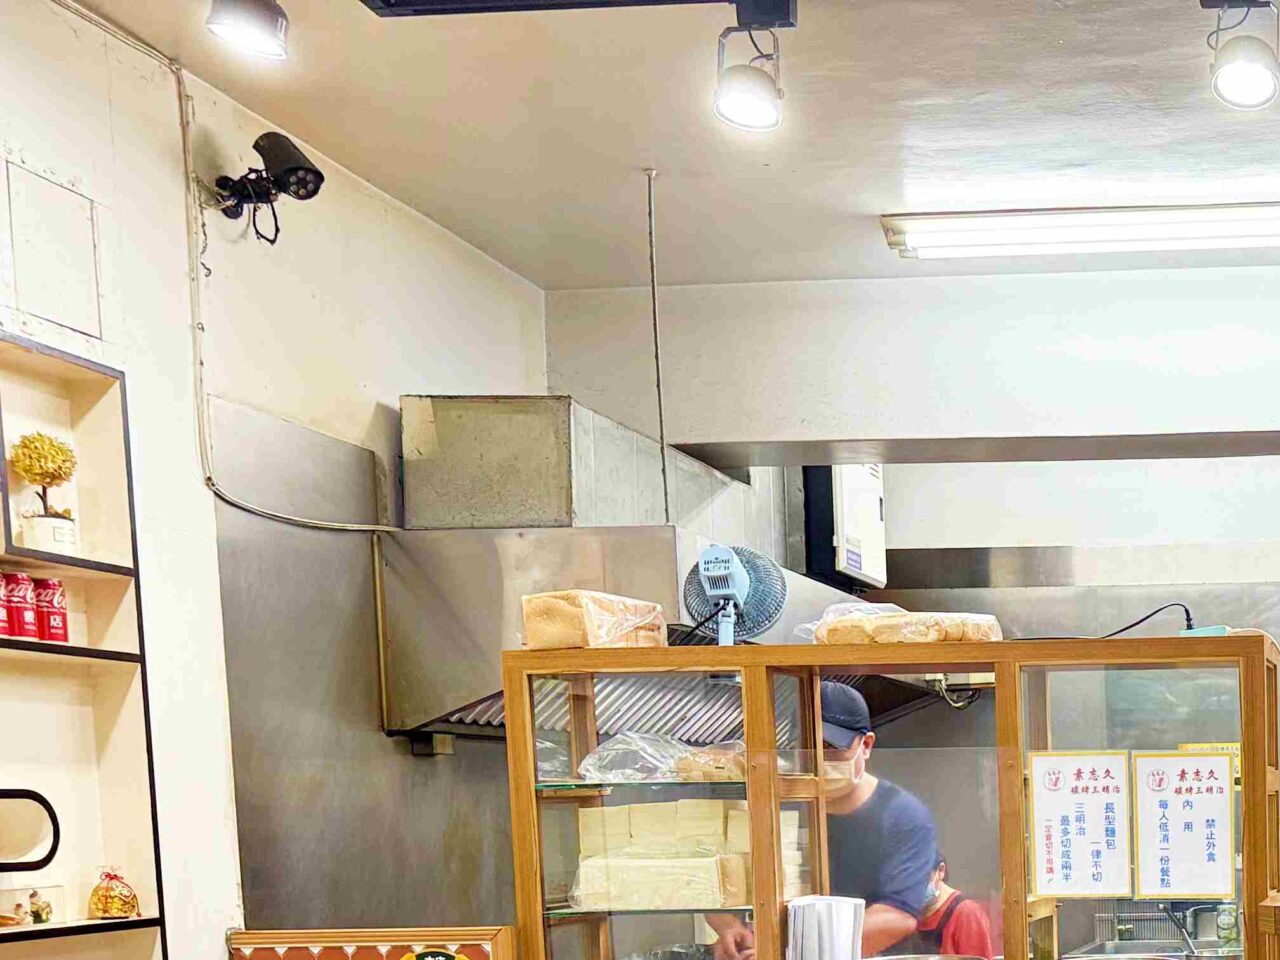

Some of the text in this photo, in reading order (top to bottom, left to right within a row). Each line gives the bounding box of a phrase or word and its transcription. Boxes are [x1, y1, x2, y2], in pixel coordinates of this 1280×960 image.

[1075, 802, 1086, 836] 三明治
[1205, 818, 1216, 863] 禁止外食
